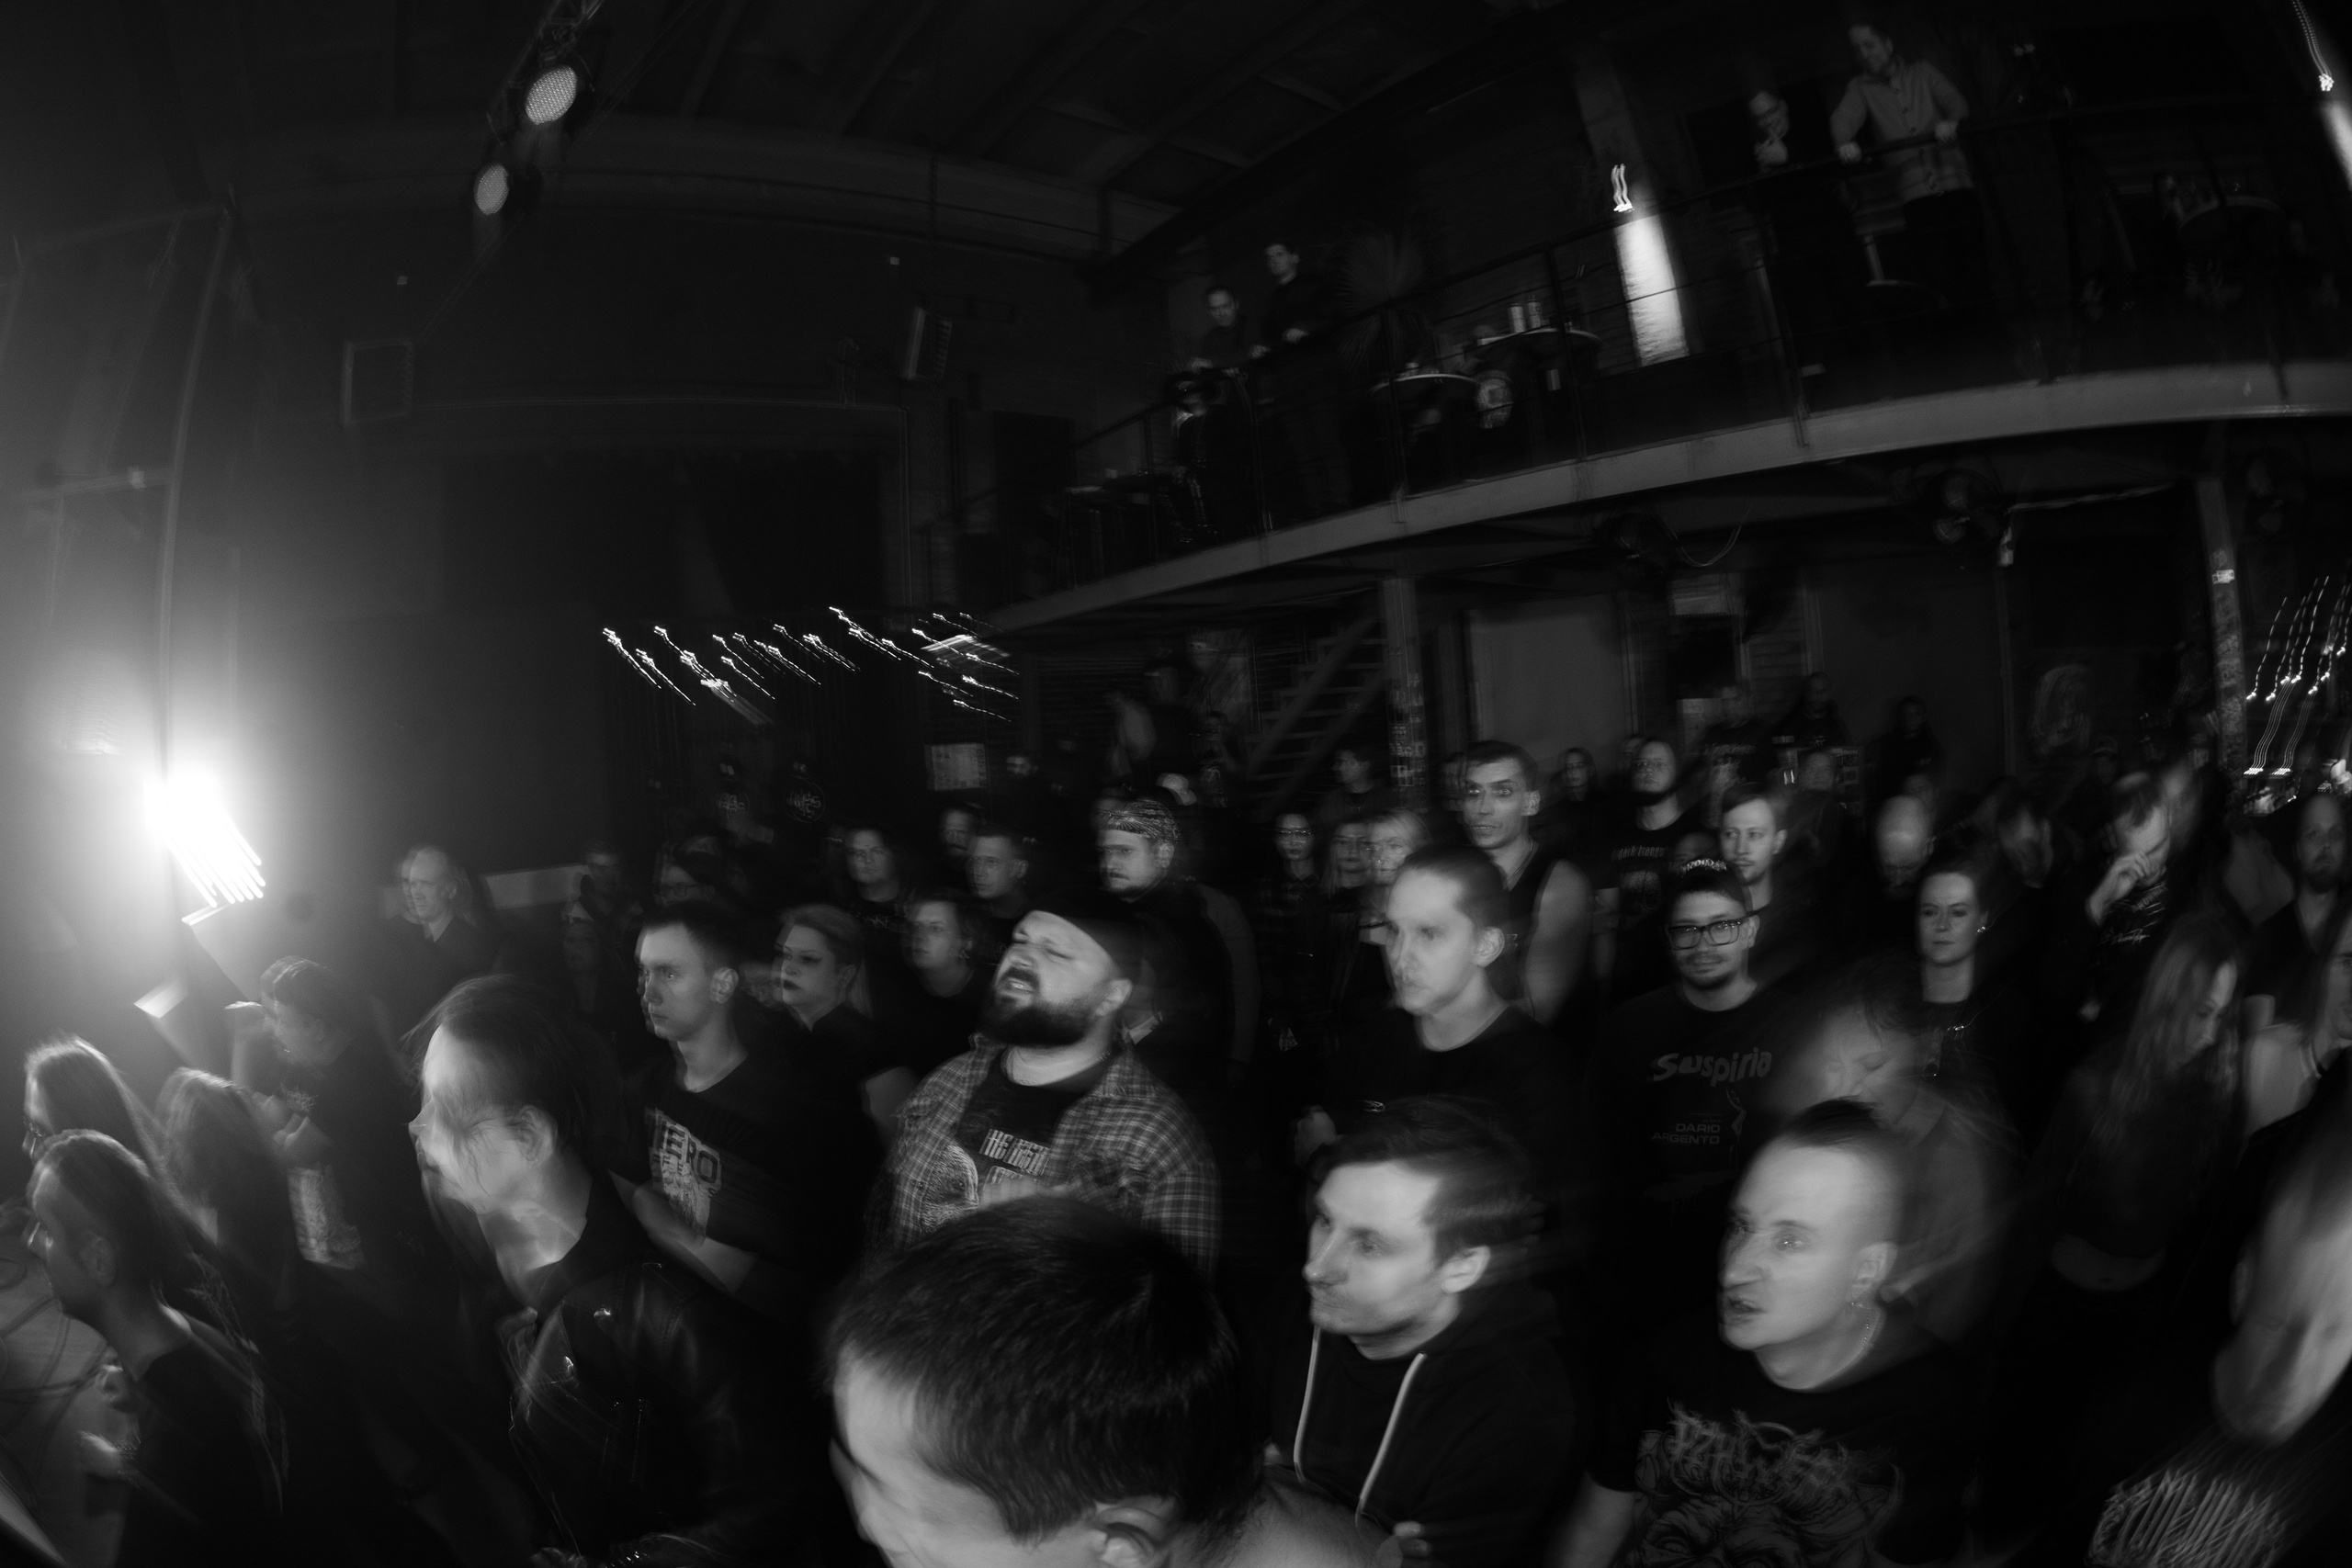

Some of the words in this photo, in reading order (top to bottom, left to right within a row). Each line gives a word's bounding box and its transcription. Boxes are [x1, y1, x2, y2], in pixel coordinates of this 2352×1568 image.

[1648, 1046, 1772, 1088] Suspiria
[1675, 1122, 1721, 1134] DARIO
[1652, 1132, 1720, 1145] ARGENTO
